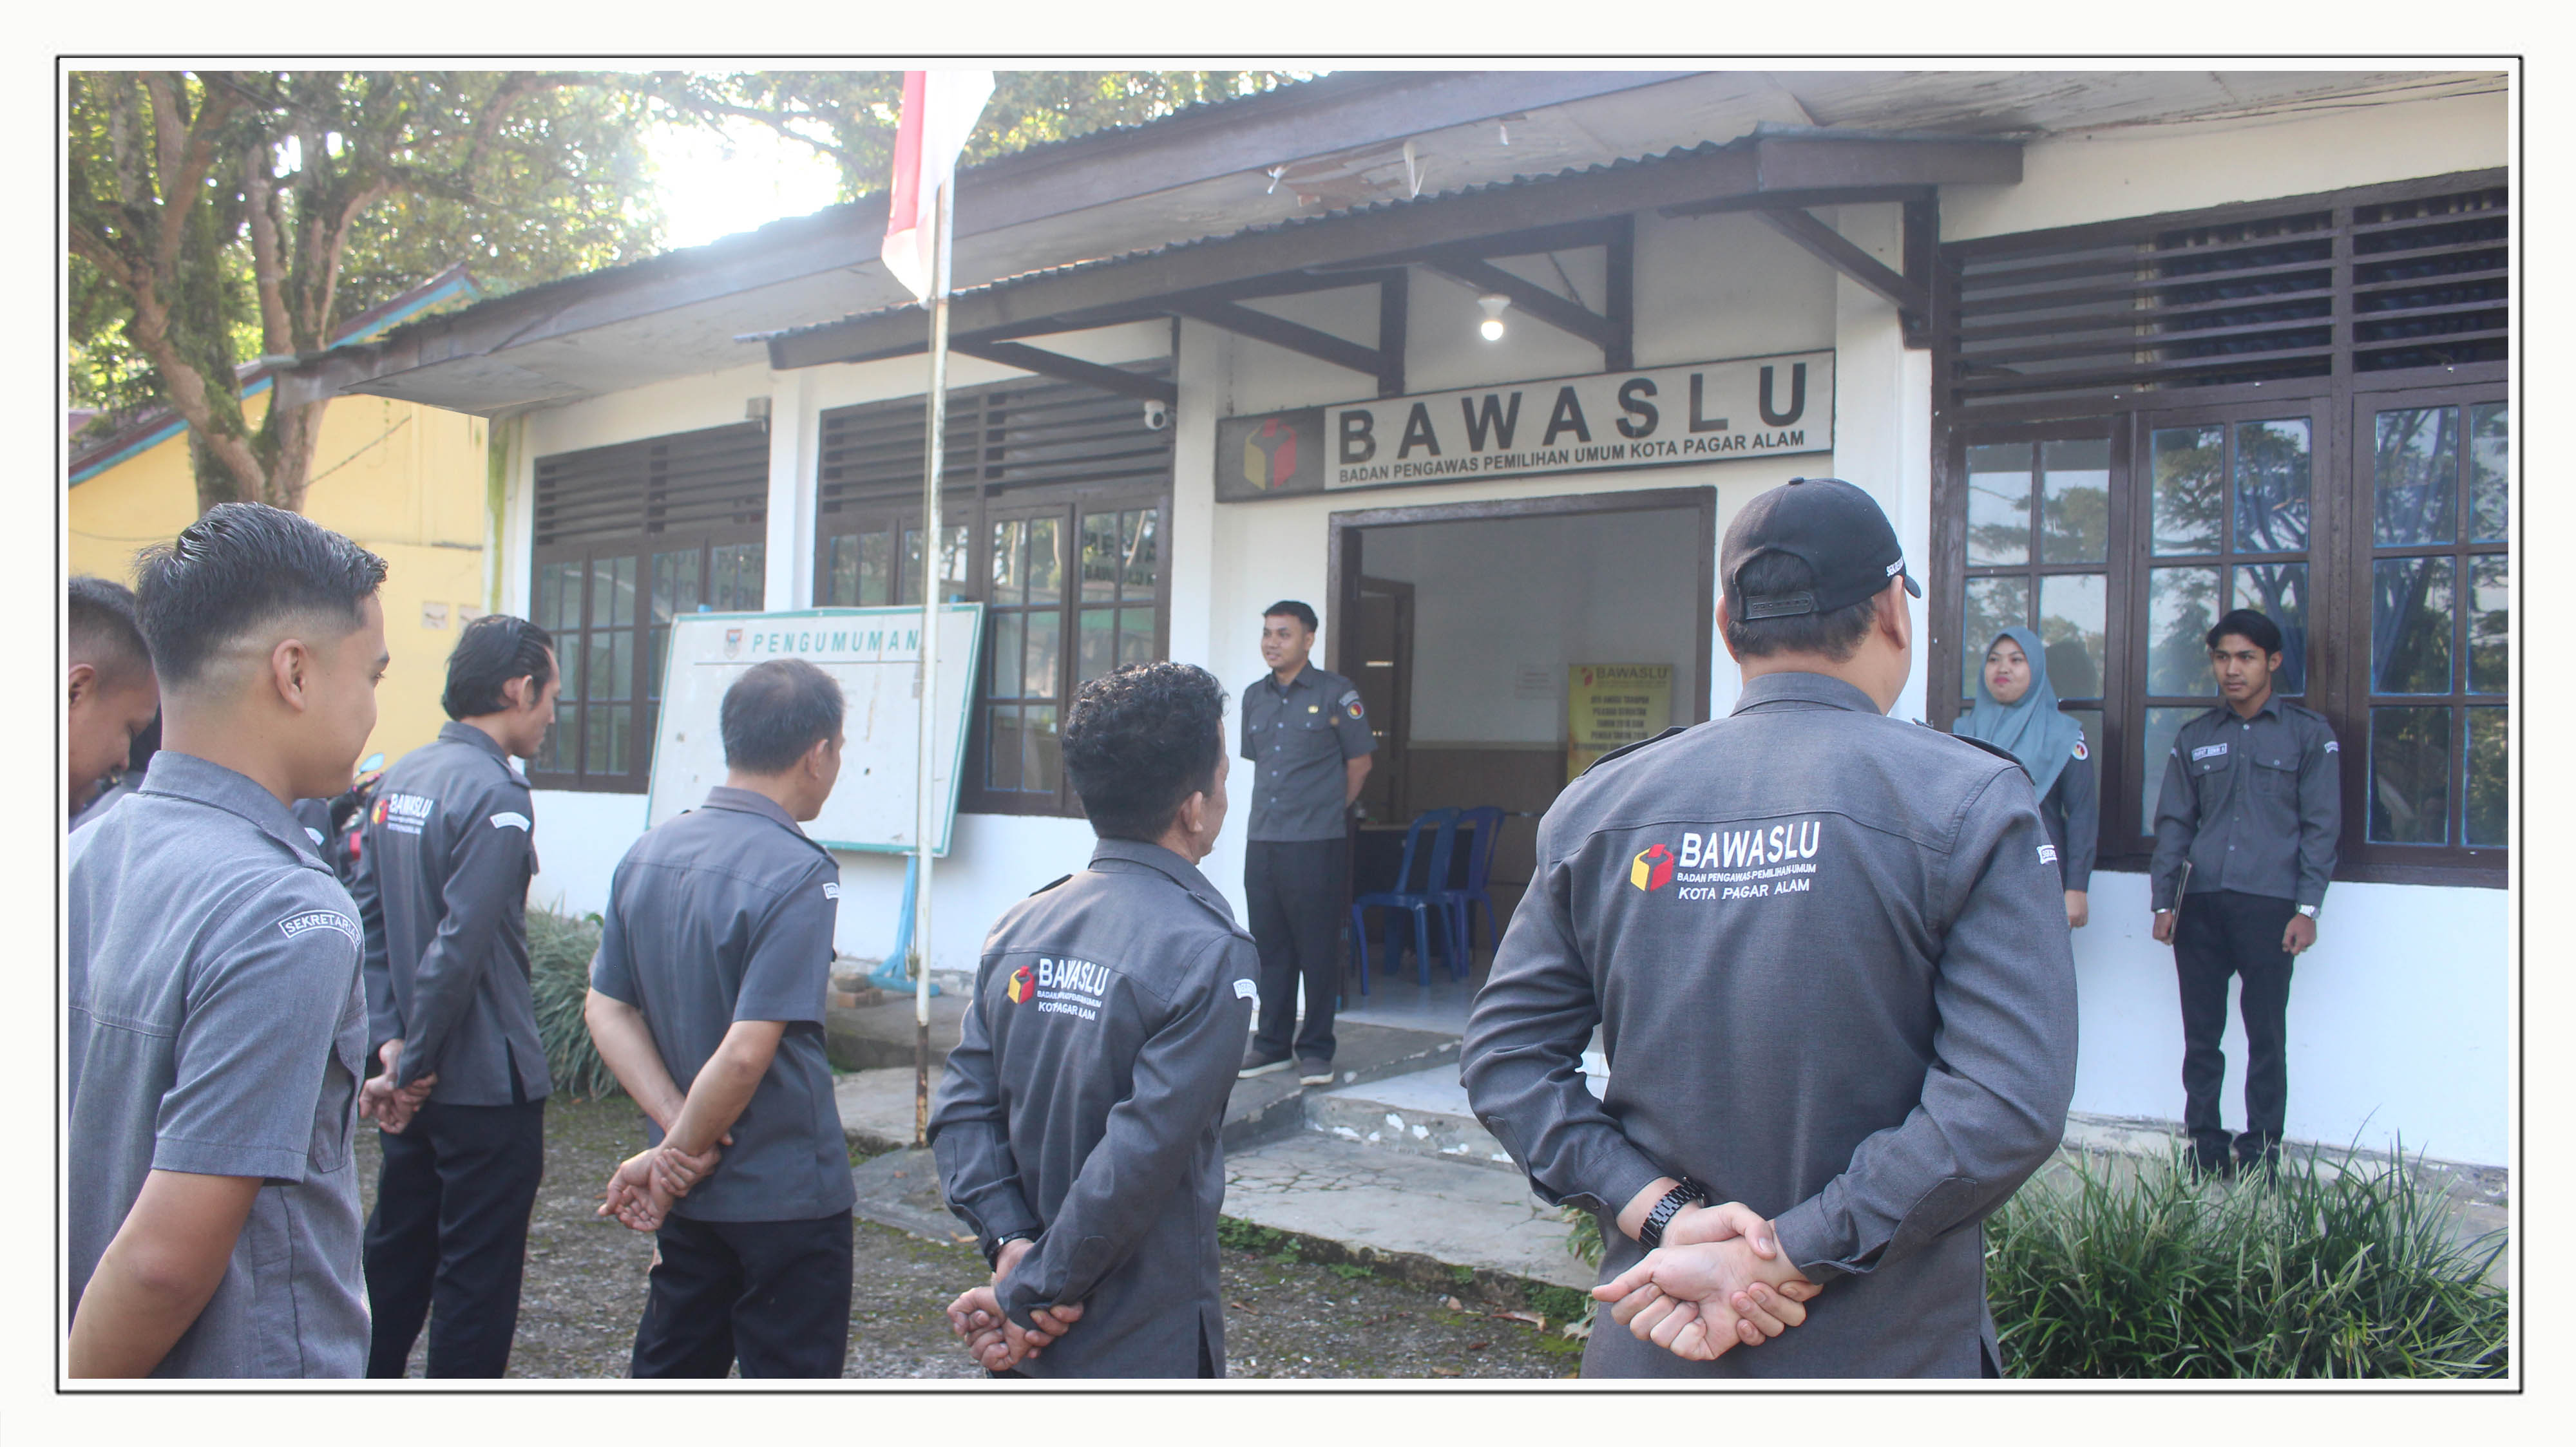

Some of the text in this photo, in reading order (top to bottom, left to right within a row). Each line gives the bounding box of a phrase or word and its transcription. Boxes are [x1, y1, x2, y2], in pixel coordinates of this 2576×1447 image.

[1339, 363, 1806, 464] BAWASLU
[1339, 430, 1804, 483] BADAN PENGAWAS PEMILIHAN UMUM KOTA PAGAR ALAM
[752, 629, 920, 653] PENGUMUMAN
[1596, 667, 1667, 679] BAWASLU
[1679, 821, 1820, 869] BAWASLU
[1677, 873, 1706, 883] BADAN
[1708, 870, 1751, 882] PENGAWAS
[1792, 864, 1817, 875] UMUM
[1677, 878, 1809, 900] KOTA PAGAR ALAM
